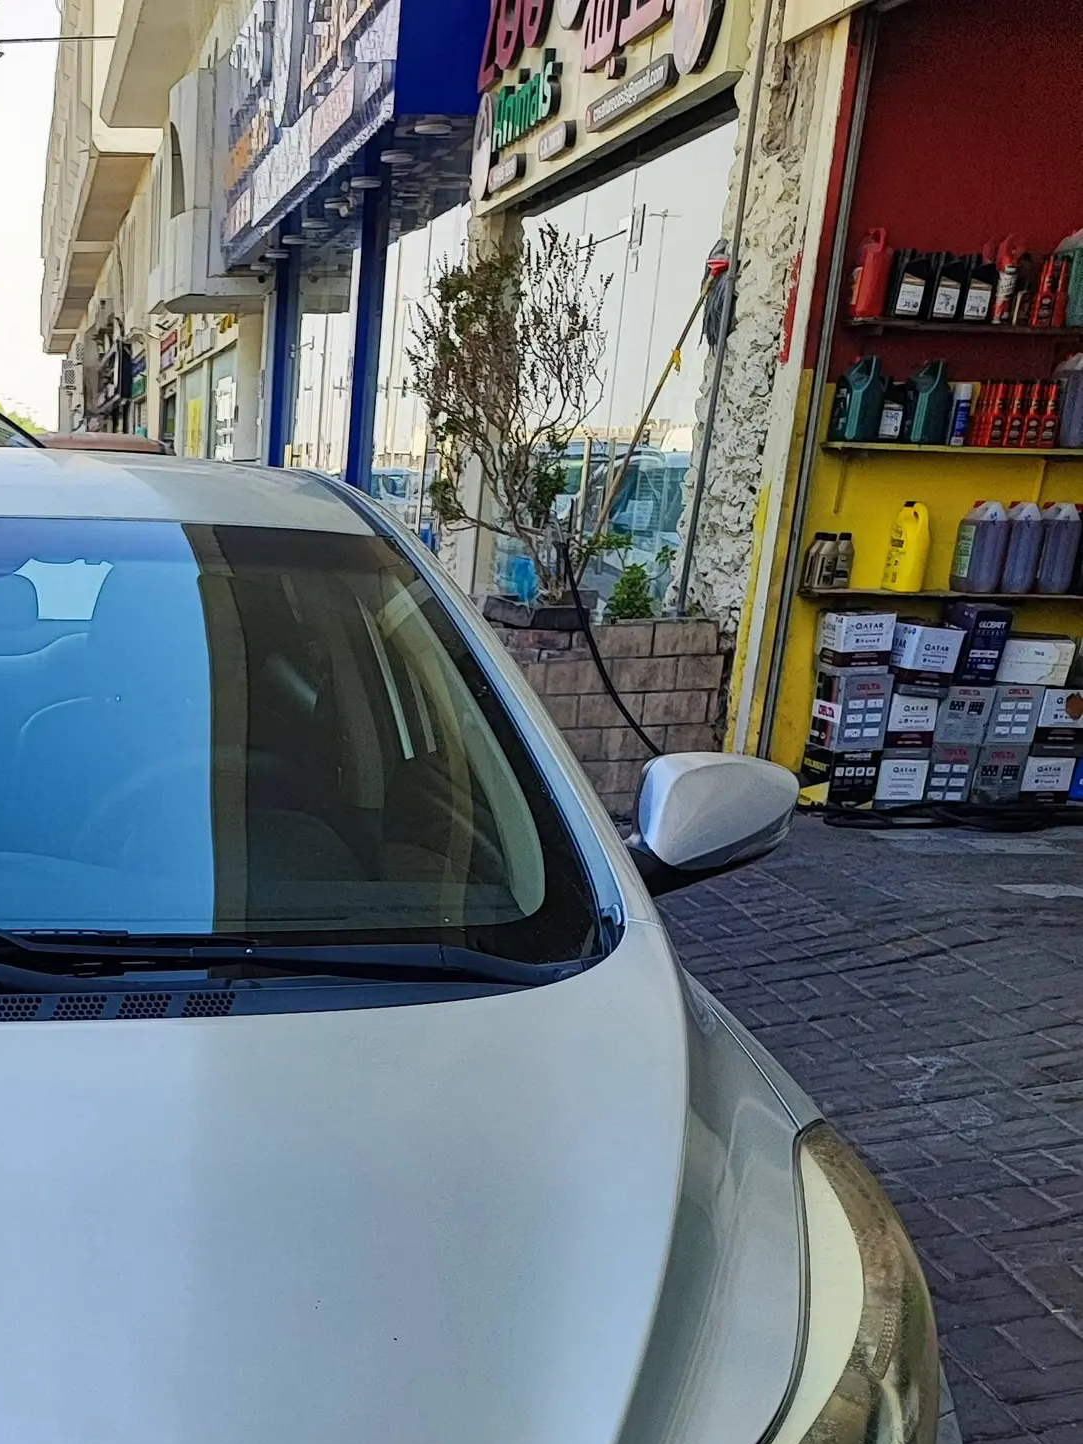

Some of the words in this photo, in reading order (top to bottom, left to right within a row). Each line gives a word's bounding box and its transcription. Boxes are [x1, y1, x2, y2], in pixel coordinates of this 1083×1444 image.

[855, 622, 884, 630] QATAR
[924, 643, 950, 652] QATAR
[1037, 765, 1061, 773] QATAR
